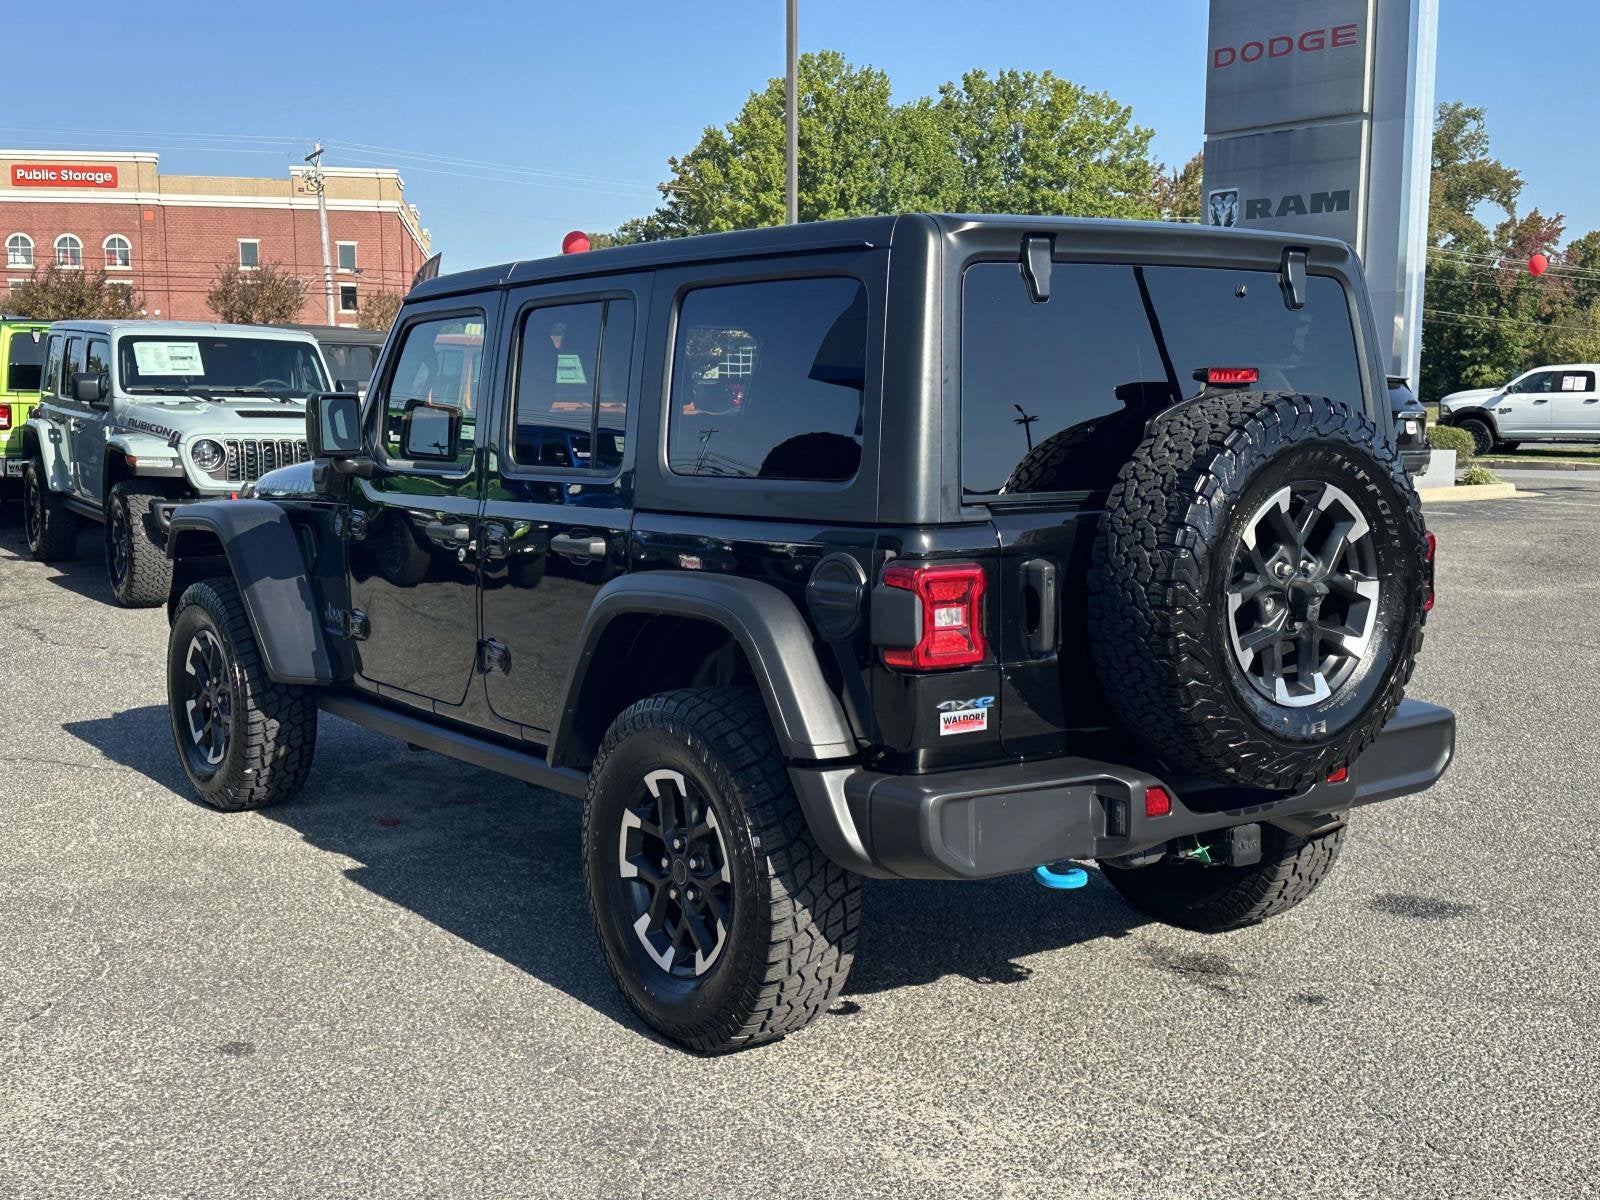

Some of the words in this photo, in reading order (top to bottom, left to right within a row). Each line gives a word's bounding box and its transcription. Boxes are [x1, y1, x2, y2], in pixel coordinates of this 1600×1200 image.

[1214, 24, 1357, 69] DODGE
[16, 169, 57, 180] Public
[60, 170, 113, 184] Storage
[1245, 190, 1351, 220] RAM
[128, 417, 173, 437] RUBICON
[943, 712, 985, 725] WALDORF
